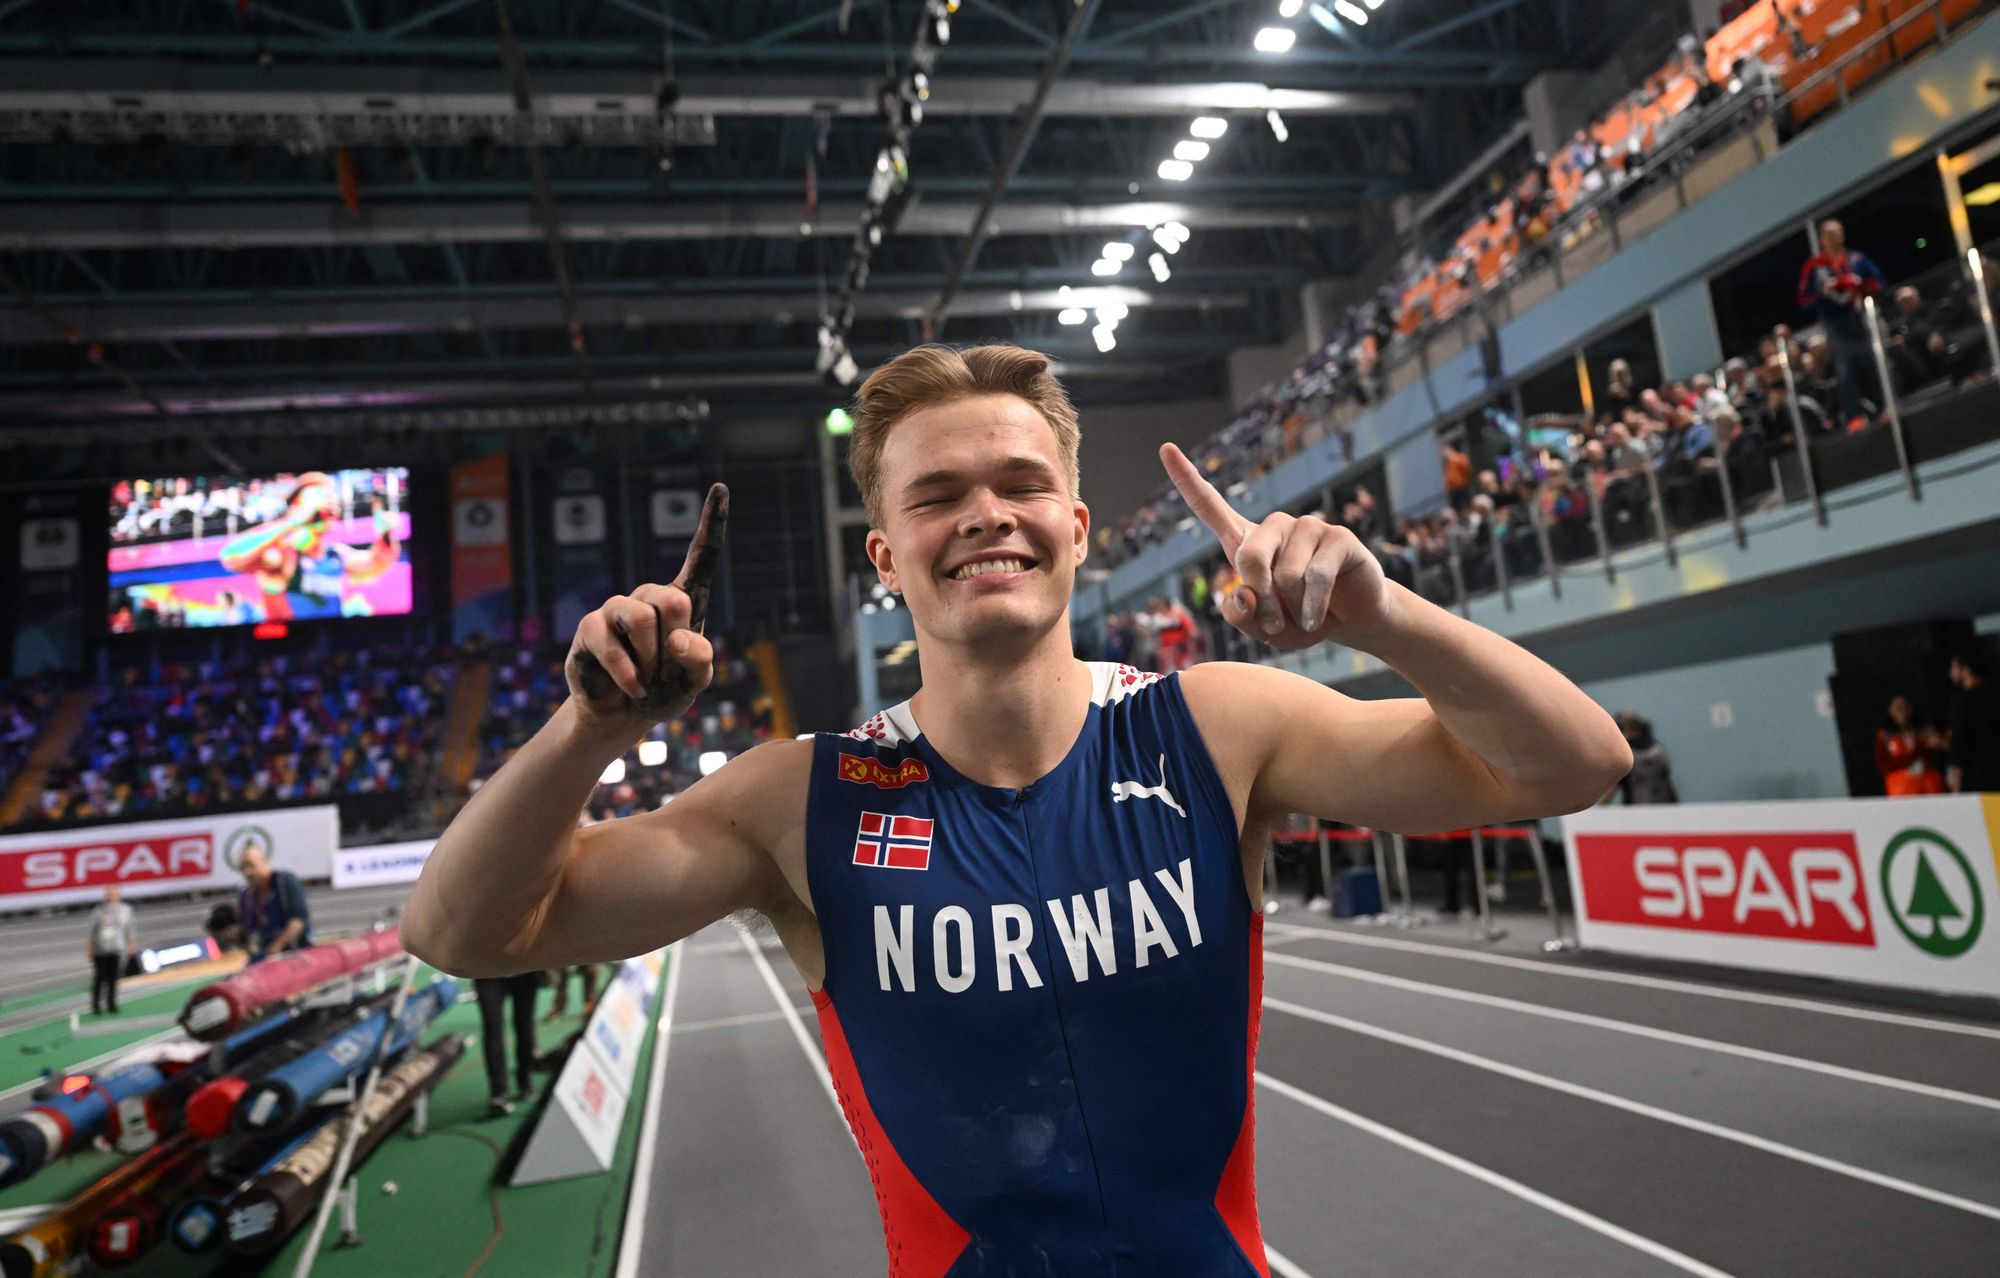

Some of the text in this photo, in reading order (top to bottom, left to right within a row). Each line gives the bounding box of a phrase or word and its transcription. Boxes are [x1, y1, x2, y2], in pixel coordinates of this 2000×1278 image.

[873, 765, 920, 783] EXTRA
[23, 838, 209, 888] SPAR
[1634, 847, 1866, 931] SPAR
[874, 858, 1203, 993] NORWAY
